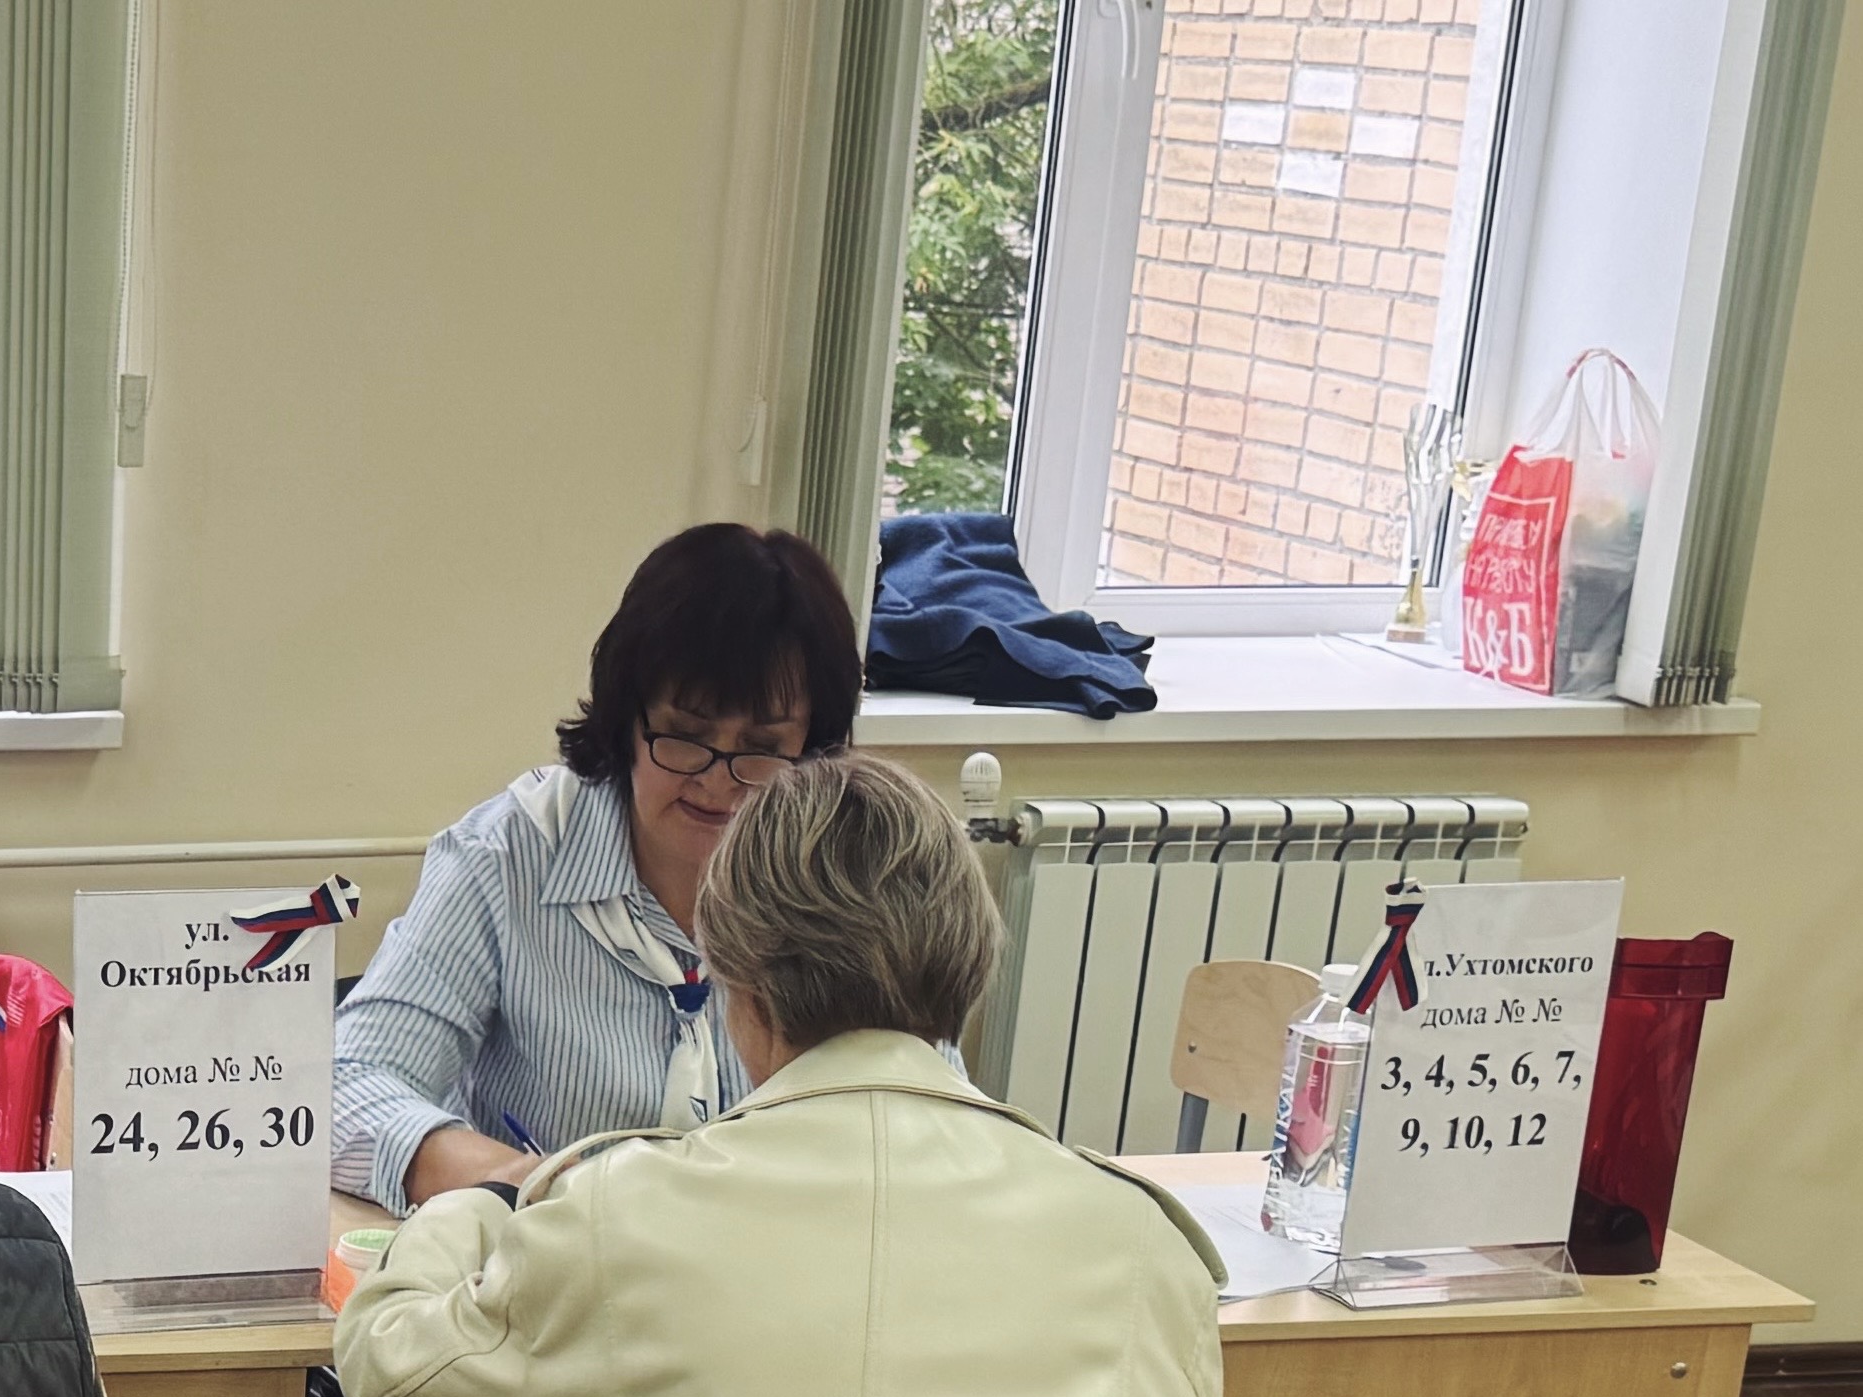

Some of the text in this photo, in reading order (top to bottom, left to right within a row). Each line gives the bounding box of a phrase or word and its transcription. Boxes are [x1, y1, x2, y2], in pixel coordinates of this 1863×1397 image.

[184, 922, 230, 950] ул.
[100, 957, 311, 993] Октябрьская
[1424, 953, 1594, 977] л.Ухтомского
[1420, 998, 1563, 1029] дома № №
[125, 1055, 283, 1090] дома № №
[1380, 1050, 1582, 1096] 3, 4, 5, 6, 7,
[90, 1105, 315, 1162] 24, 26, 30
[1398, 1112, 1547, 1157] 9, 10, 12
